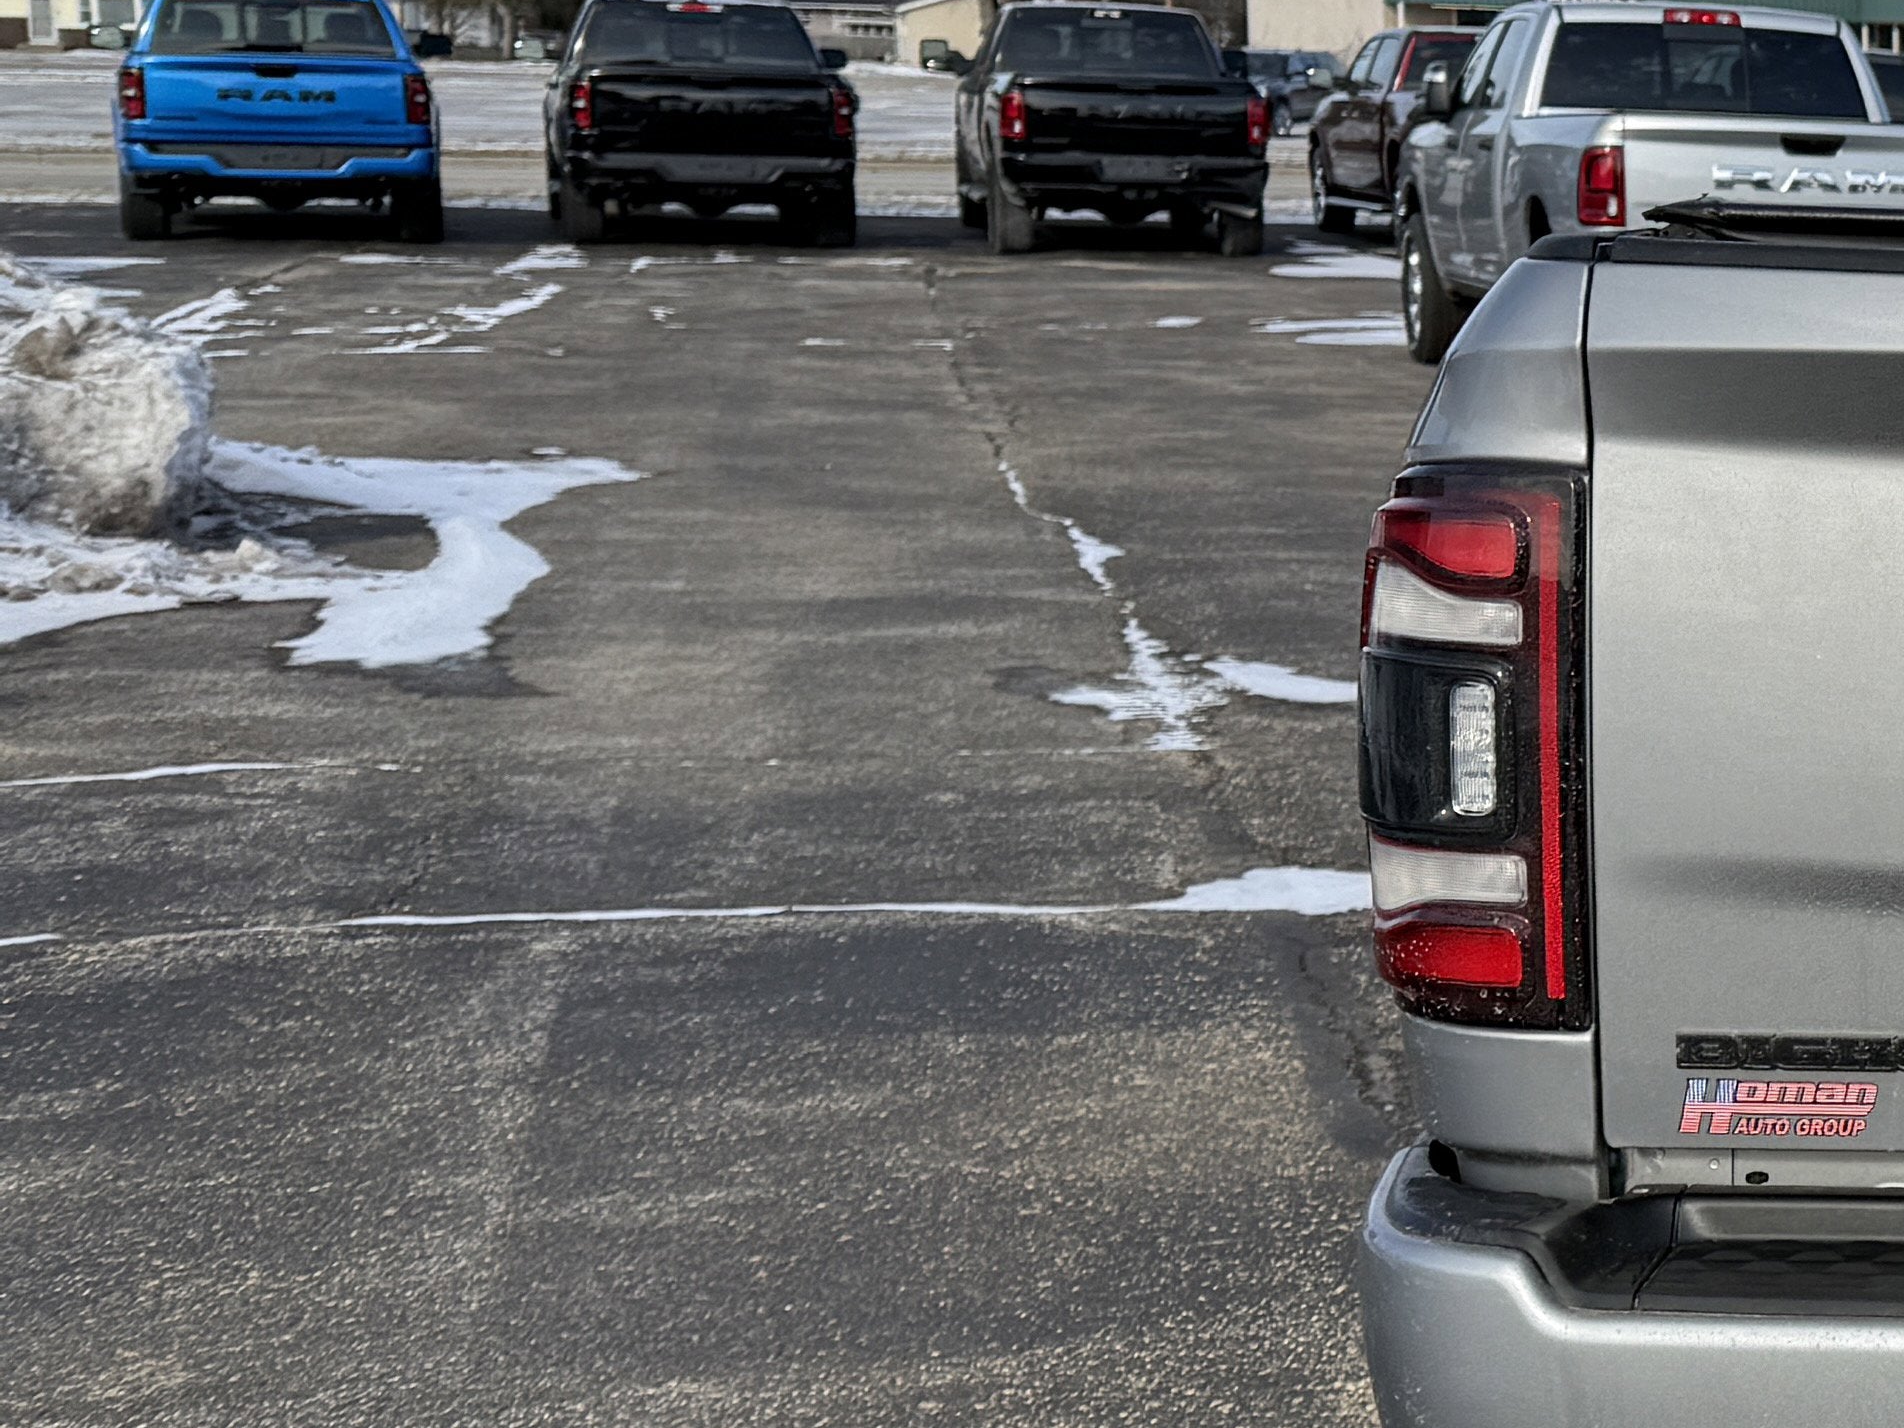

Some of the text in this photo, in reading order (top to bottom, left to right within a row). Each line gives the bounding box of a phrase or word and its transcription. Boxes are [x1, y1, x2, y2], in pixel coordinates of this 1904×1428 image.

[216, 87, 337, 103] RAM
[1732, 1116, 1867, 1137] AUTO GROUP
